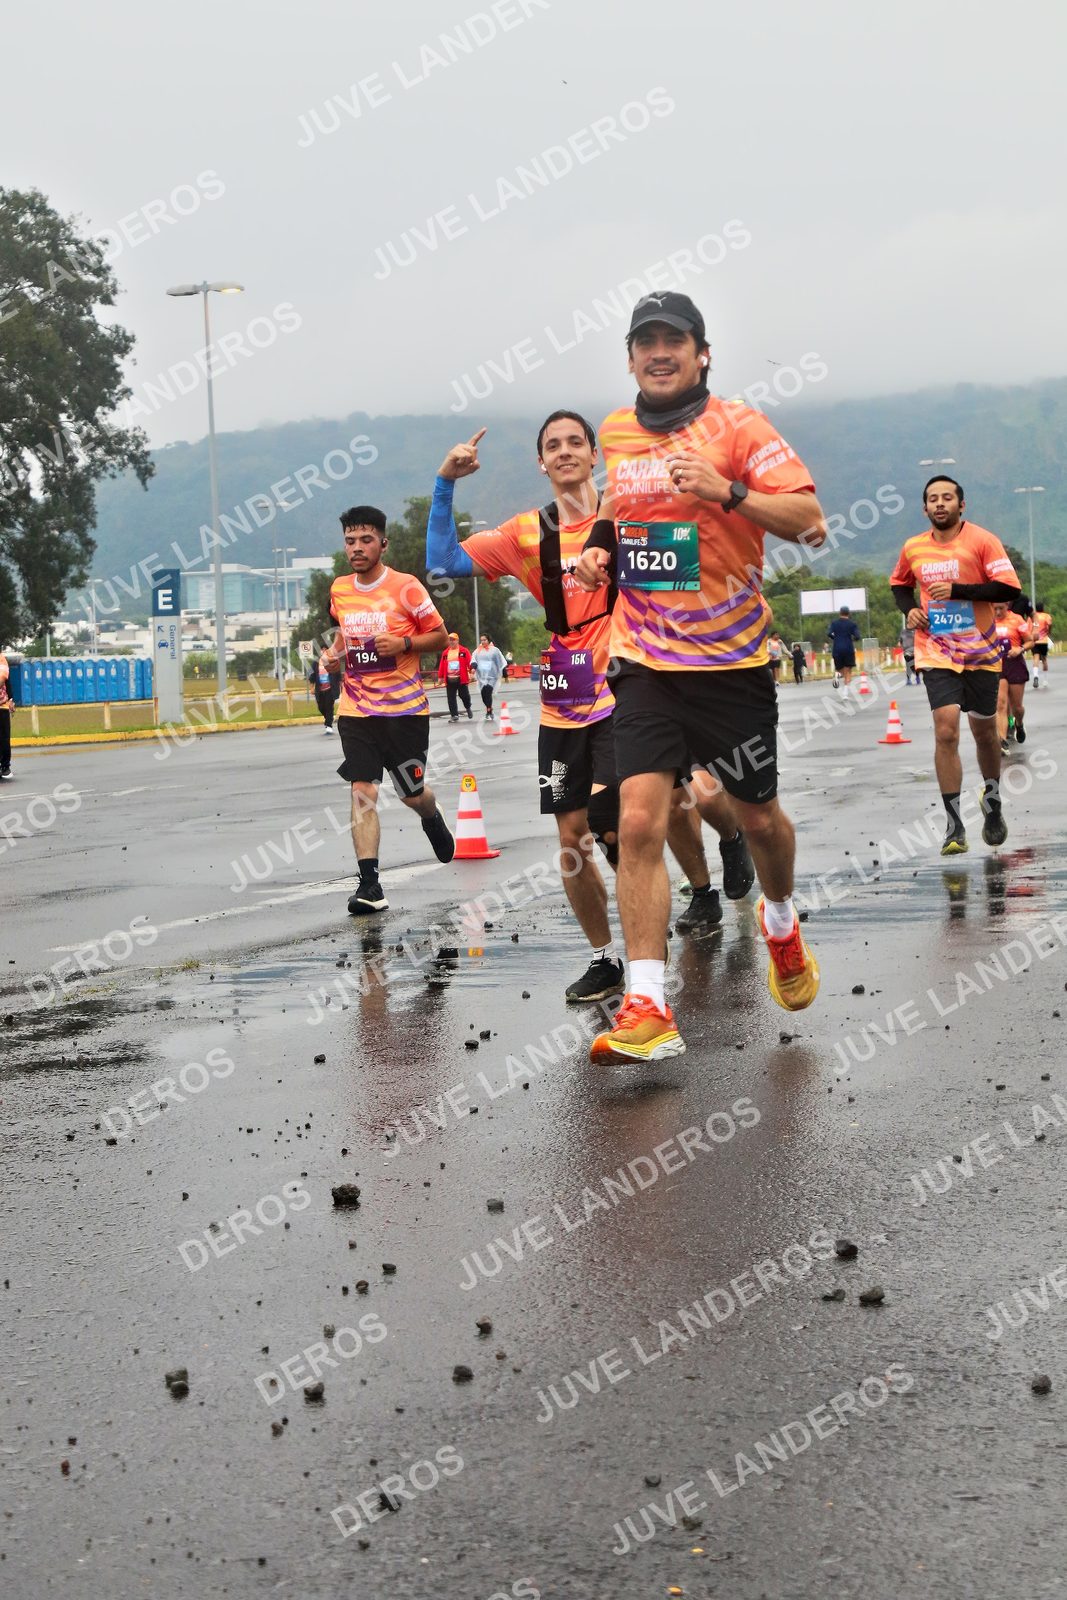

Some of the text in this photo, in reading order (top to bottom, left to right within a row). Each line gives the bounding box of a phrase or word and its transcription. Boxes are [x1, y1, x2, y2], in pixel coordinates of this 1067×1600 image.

[616, 459, 671, 481] CARRE
[627, 550, 677, 571] 1620
[921, 560, 959, 574] CARRERA
[158, 589, 173, 610] E
[344, 612, 387, 625] CARRERA
[933, 613, 962, 625] 2470
[169, 625, 177, 660] General
[355, 652, 378, 663] 194
